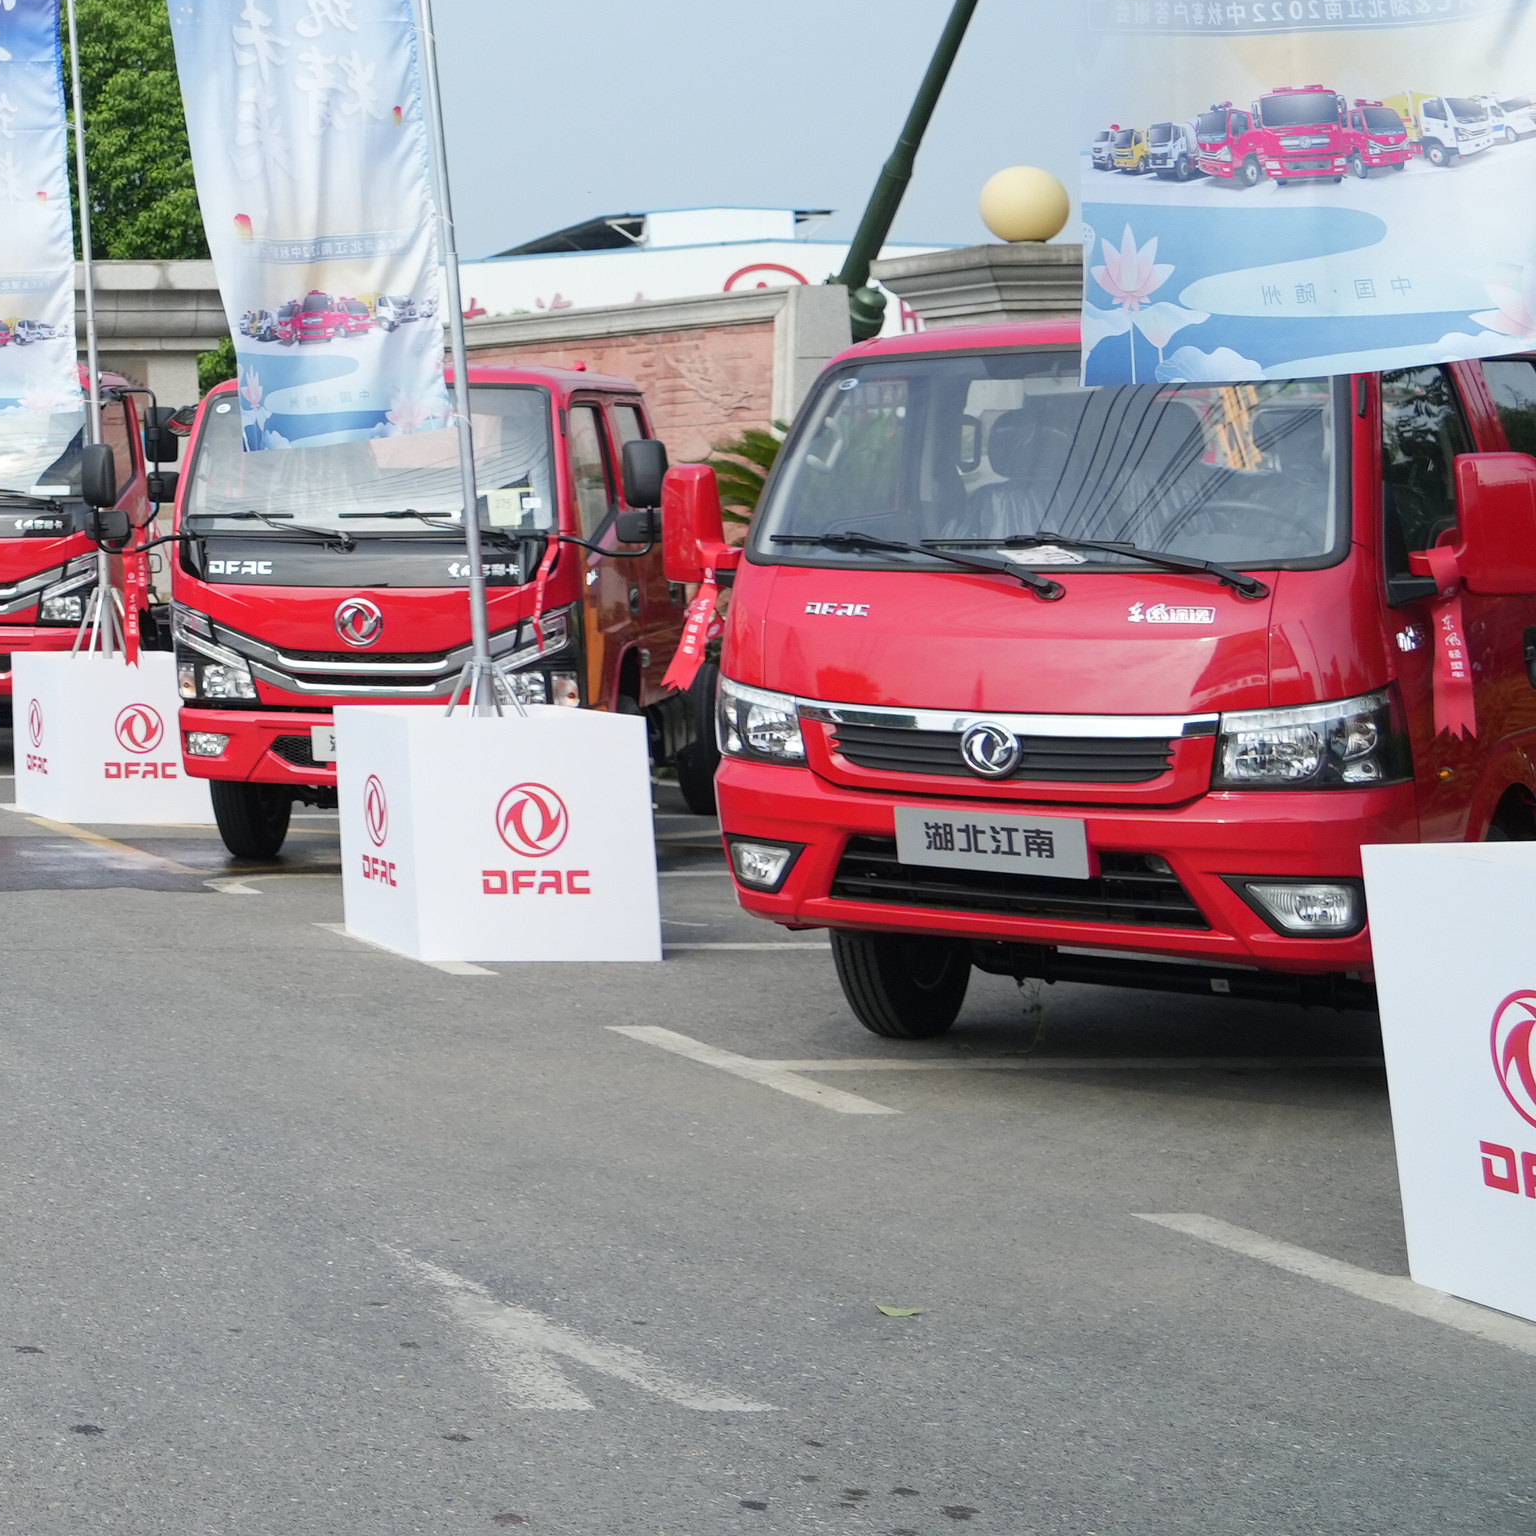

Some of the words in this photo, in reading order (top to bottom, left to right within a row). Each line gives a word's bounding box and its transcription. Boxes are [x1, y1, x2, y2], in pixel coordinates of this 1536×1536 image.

[209, 560, 273, 576] DFAC
[805, 601, 871, 618] DFAC
[25, 753, 49, 775] DFAC
[104, 761, 178, 780] DFAC
[924, 821, 1055, 860] 湖北江南
[361, 854, 398, 888] DFAC
[481, 869, 591, 895] DFAC
